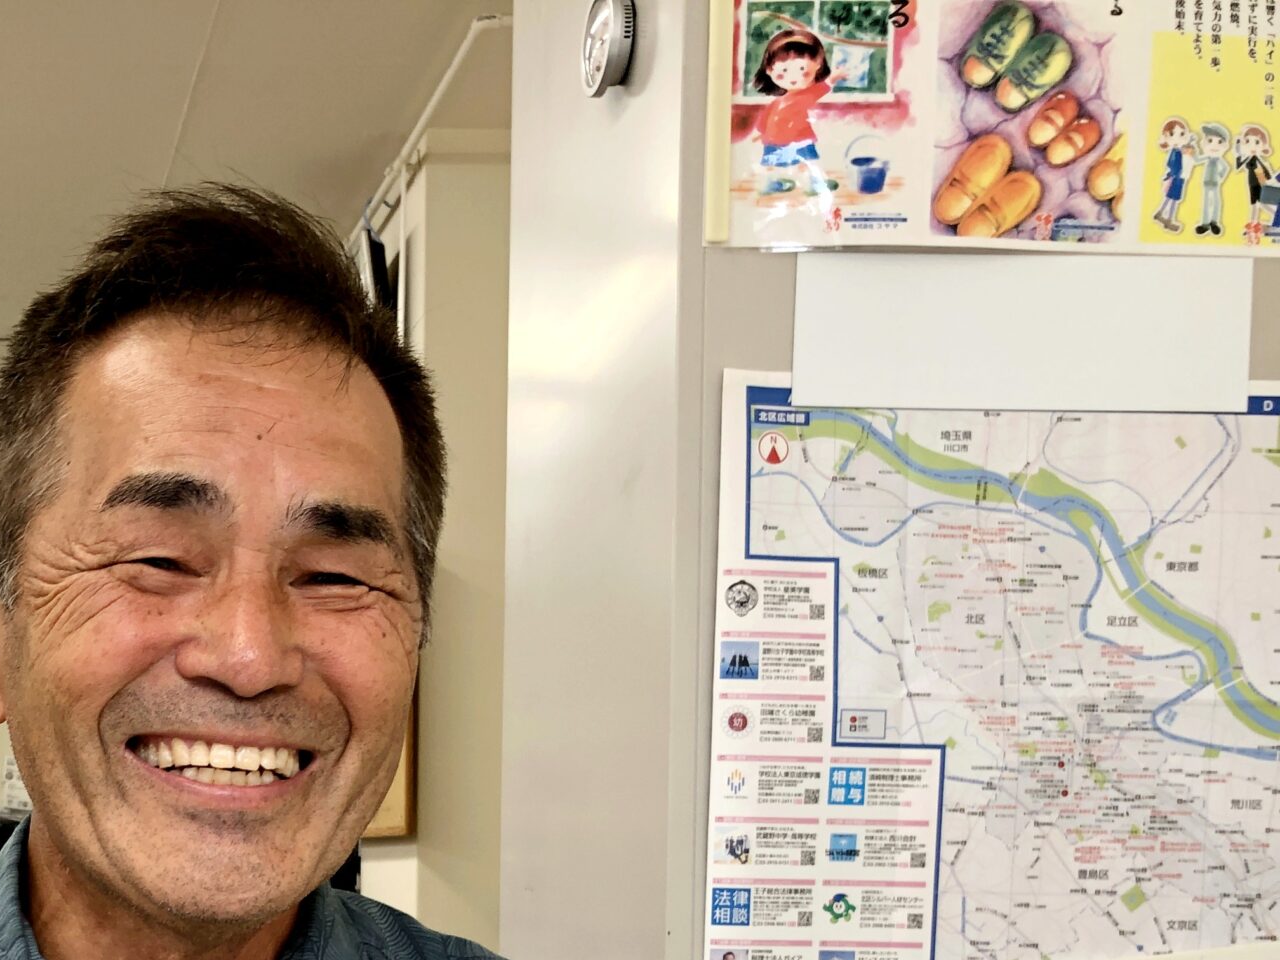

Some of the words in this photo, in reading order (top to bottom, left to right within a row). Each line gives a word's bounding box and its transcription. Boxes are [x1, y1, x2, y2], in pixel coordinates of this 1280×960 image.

[1230, 0, 1240, 28] 燃焼。
[1248, 0, 1258, 63] ずに実行を。
[1263, 400, 1274, 412] D
[940, 430, 972, 441] 埼玉県
[943, 443, 969, 453] 川口市
[1165, 561, 1199, 573] 東京都
[857, 568, 888, 580] 板橋区
[964, 613, 985, 625] 北区
[1106, 616, 1138, 628] 足立区
[832, 769, 864, 785] 相続
[1230, 799, 1263, 811] 荒川区
[1078, 869, 1109, 881] 豊島区
[713, 889, 749, 906] 法律
[712, 907, 748, 924] 相談
[1166, 919, 1198, 931] 文京区
